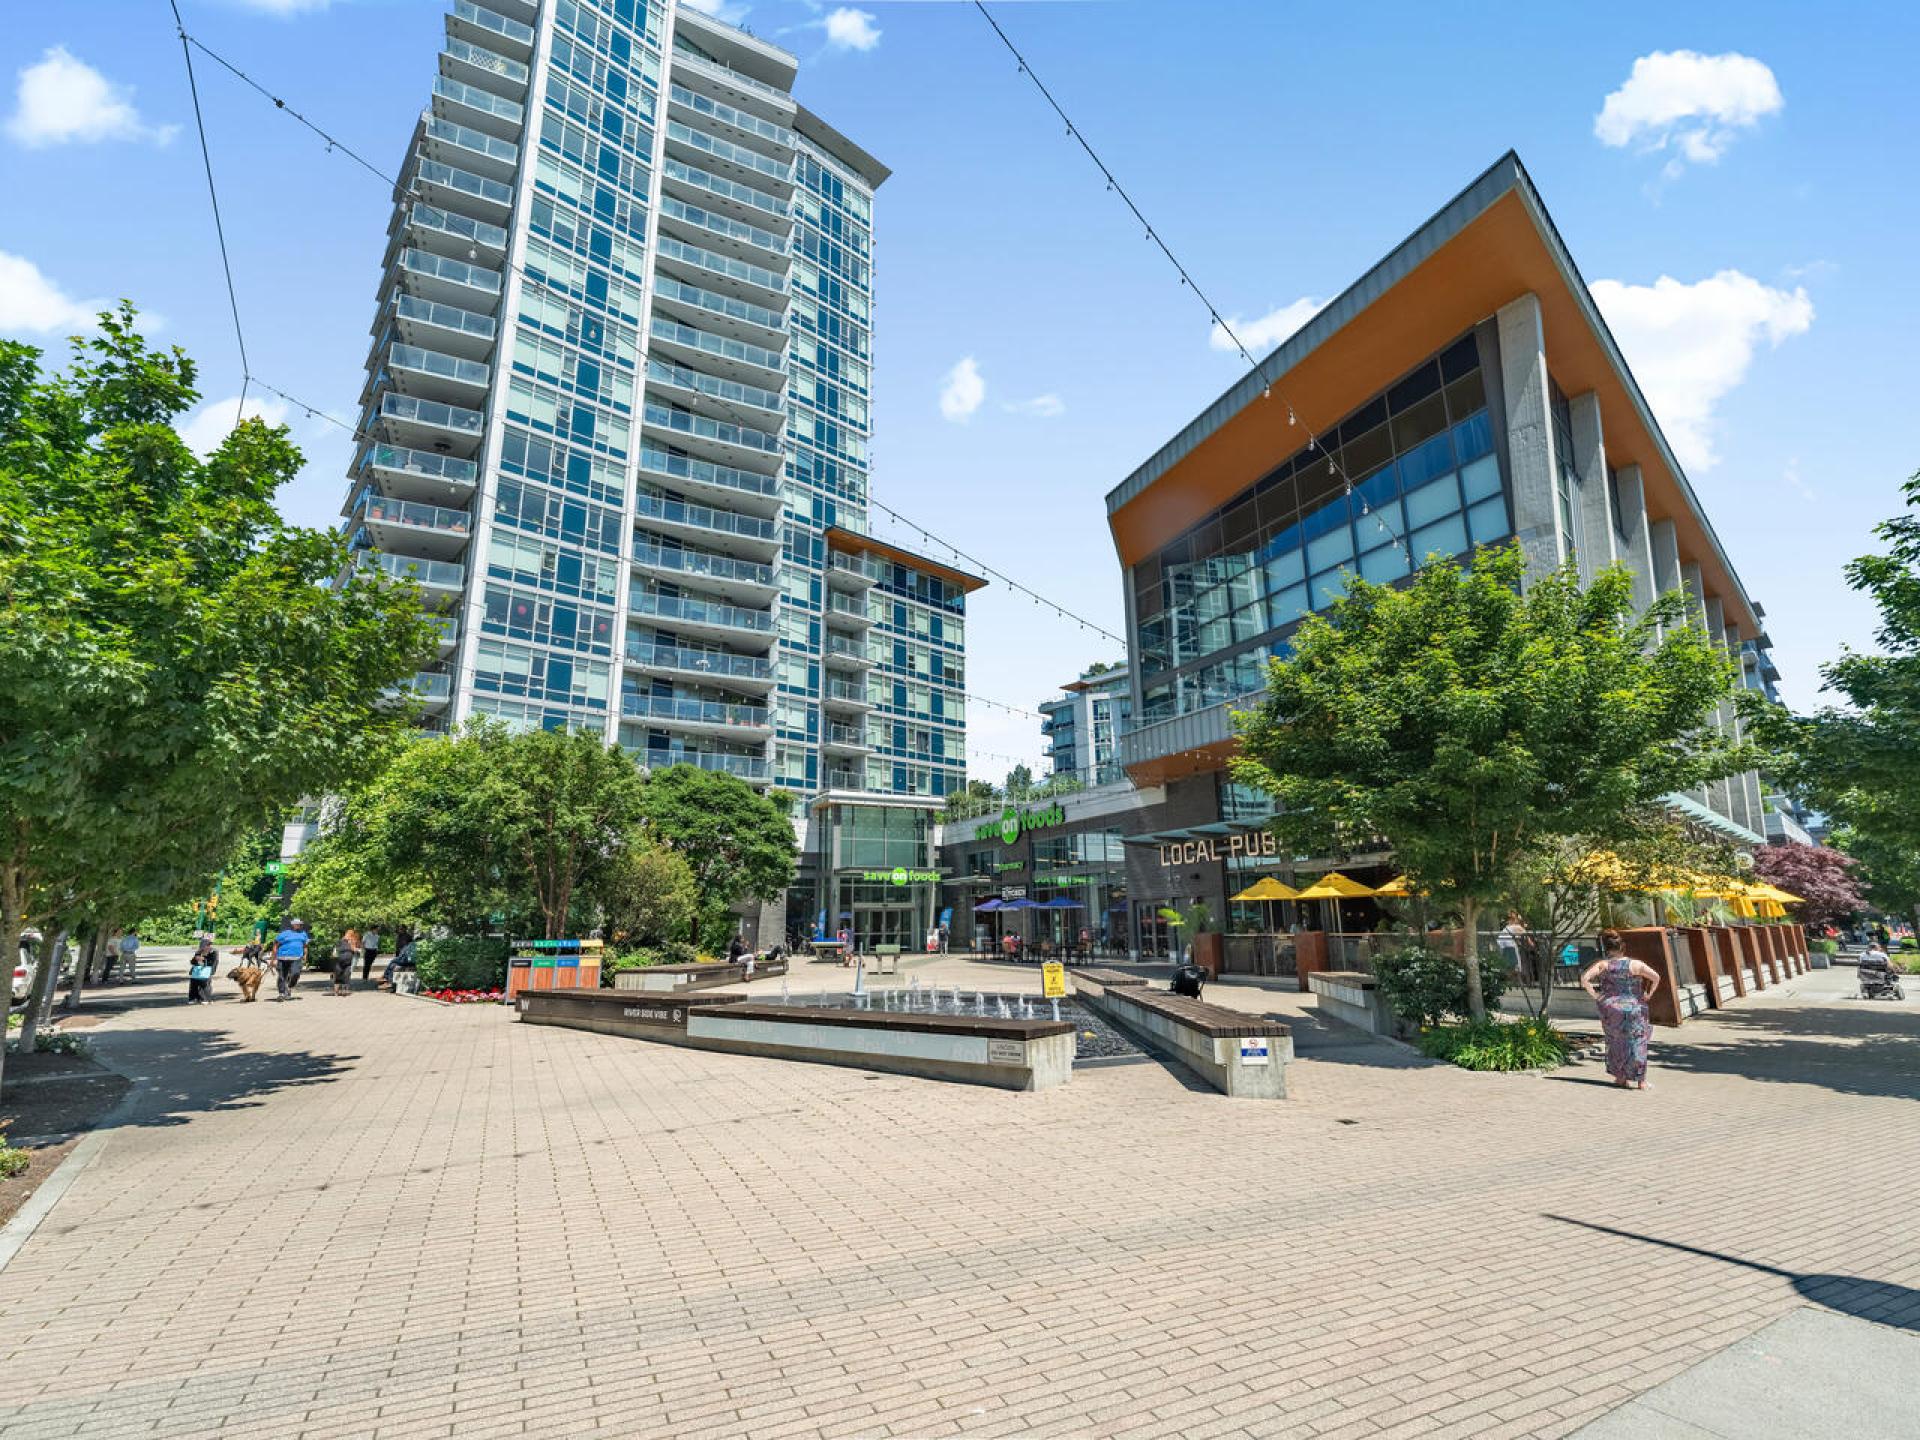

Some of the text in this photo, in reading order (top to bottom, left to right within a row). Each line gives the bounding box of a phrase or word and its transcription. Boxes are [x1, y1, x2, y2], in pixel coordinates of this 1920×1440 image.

[1002, 819, 1017, 833] on
[1021, 804, 1064, 831] foods
[1160, 831, 1282, 866] LOCAL PUB
[891, 872, 907, 880] on
[908, 870, 941, 881] foods
